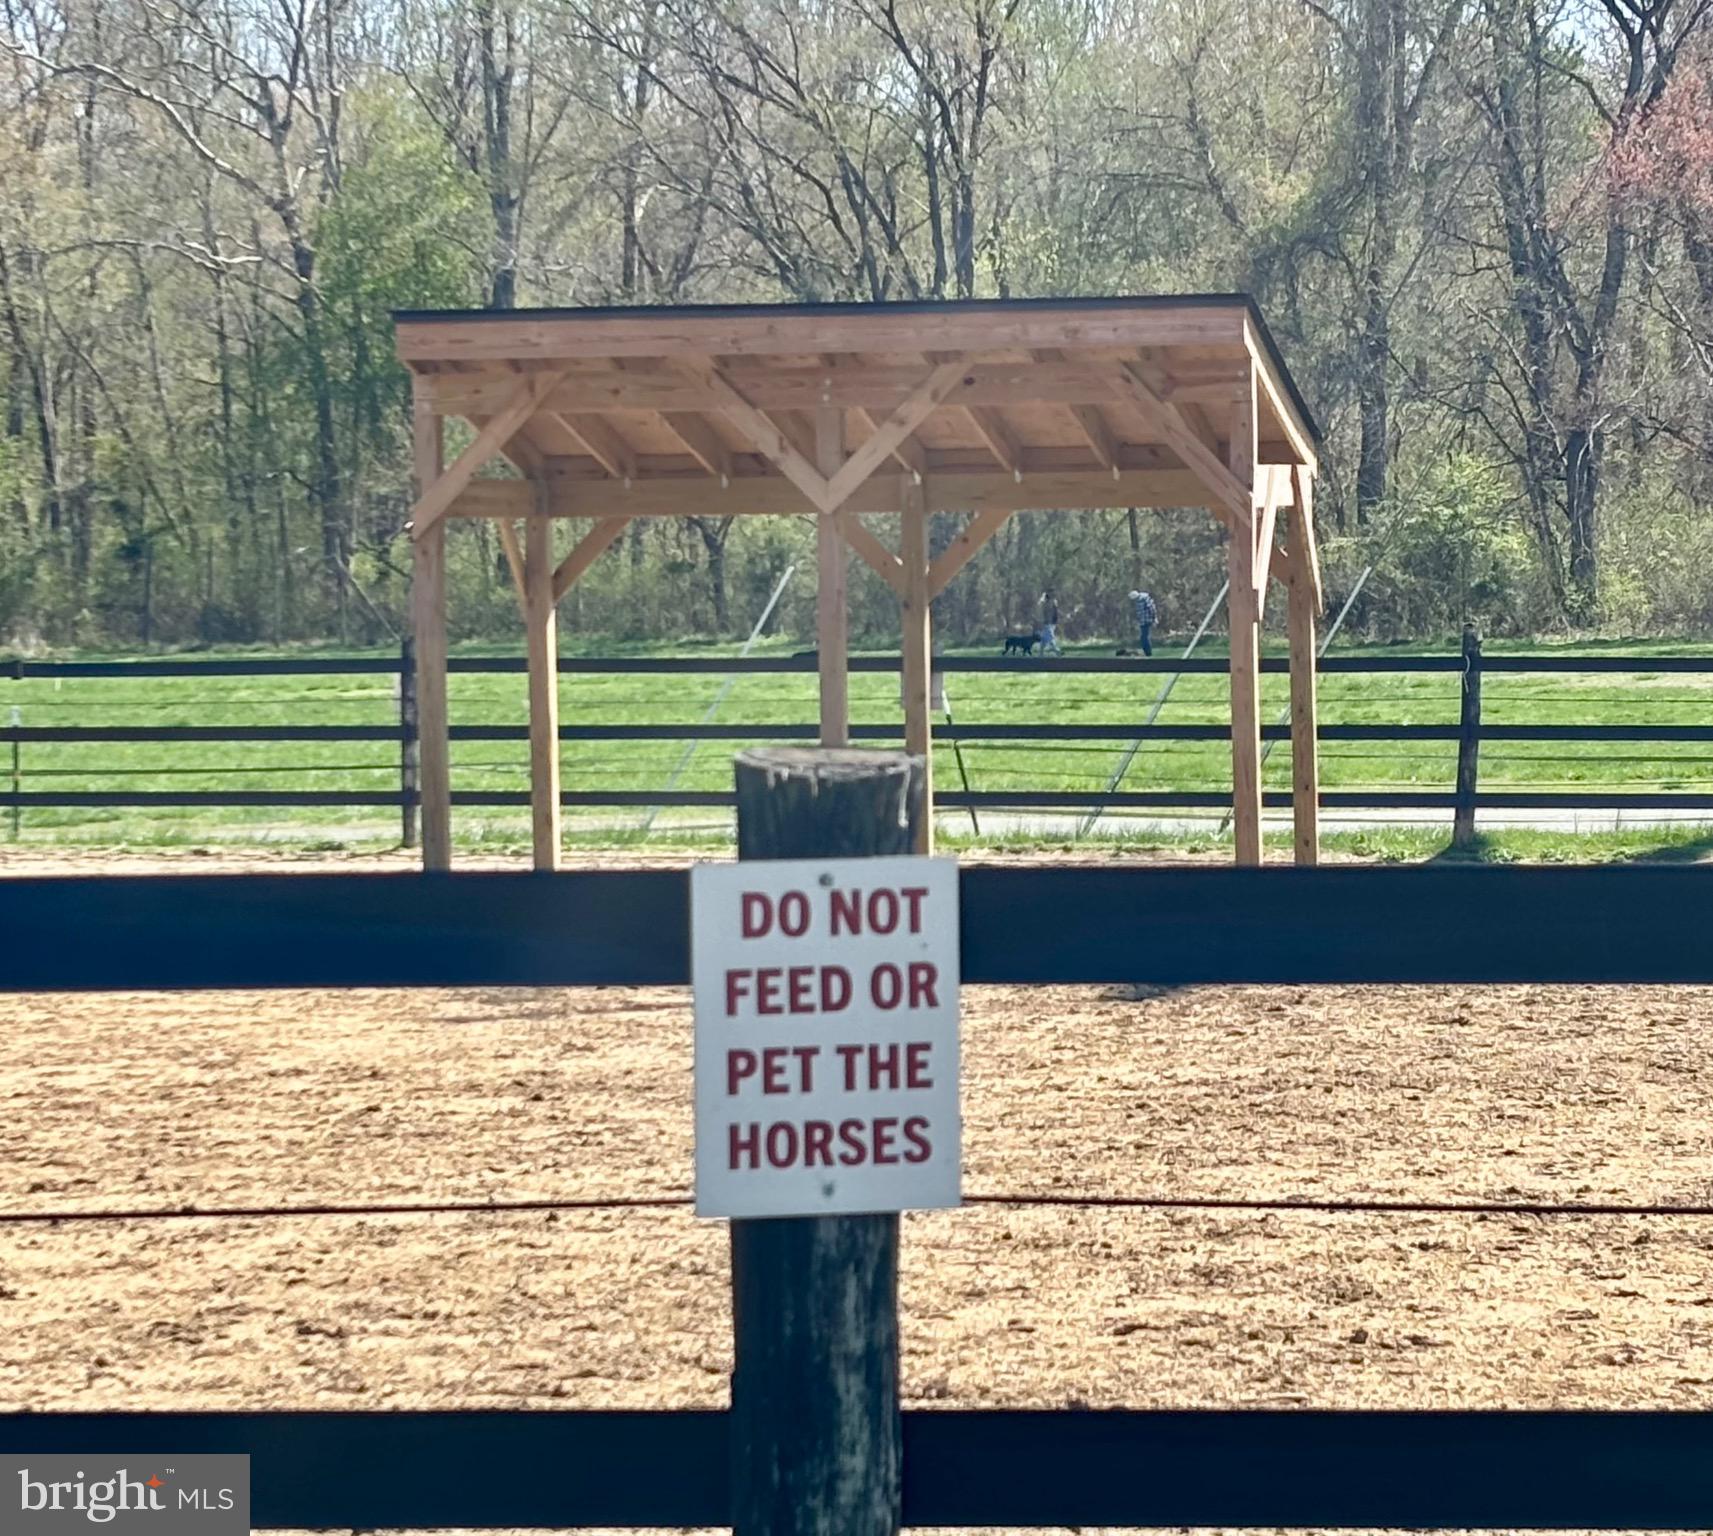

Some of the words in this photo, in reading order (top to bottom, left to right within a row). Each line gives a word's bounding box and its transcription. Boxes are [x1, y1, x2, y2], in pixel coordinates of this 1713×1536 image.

[742, 891, 811, 939] DO
[830, 887, 929, 936] NOT
[725, 965, 853, 1016] FEED
[870, 962, 939, 1011] OR
[727, 1046, 821, 1096] PET
[836, 1042, 934, 1092] THE
[728, 1115, 933, 1170] HORSES
